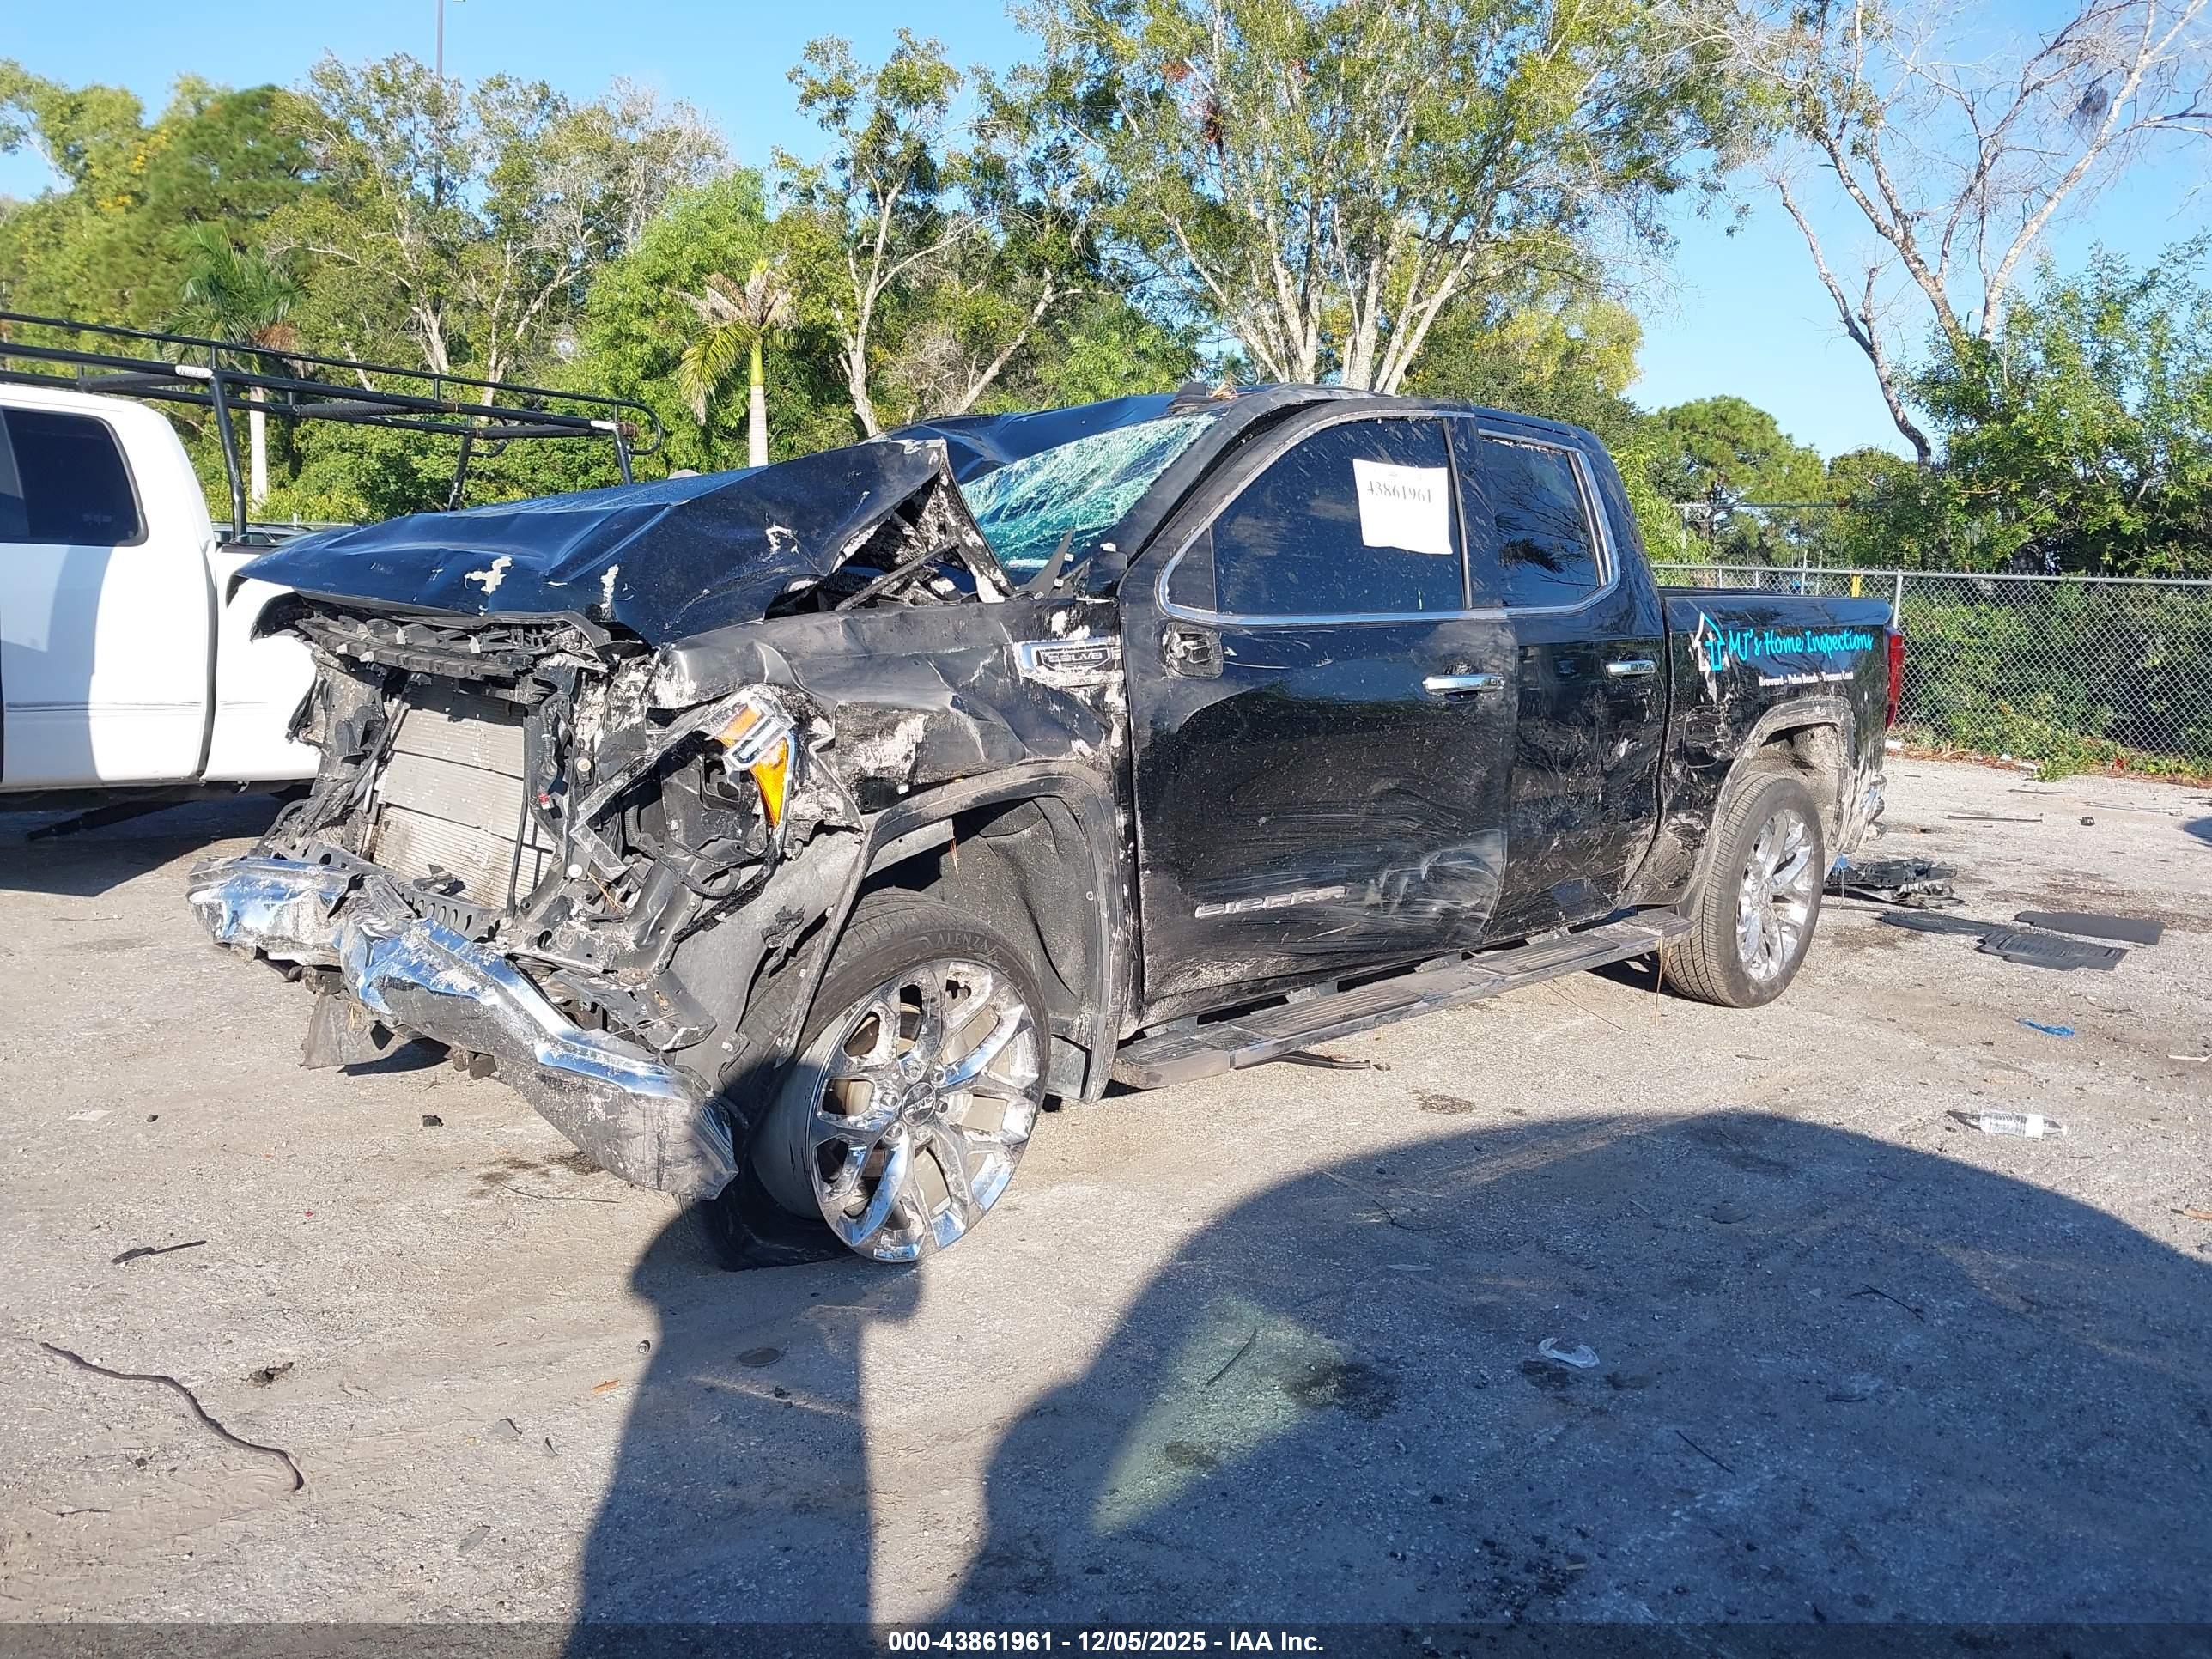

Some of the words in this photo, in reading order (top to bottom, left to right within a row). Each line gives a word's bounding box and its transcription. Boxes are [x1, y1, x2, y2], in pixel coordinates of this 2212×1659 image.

[1367, 480, 1432, 503] 43861961
[1729, 629, 1762, 661] MJ's
[1764, 629, 1804, 655] Home
[1805, 630, 1874, 659] Inspections
[1759, 674, 1784, 686] Broward
[1787, 673, 1802, 685] Palm
[1802, 672, 1819, 684] Beach
[937, 932, 988, 951] ALENZA
[904, 1091, 935, 1117] GMC
